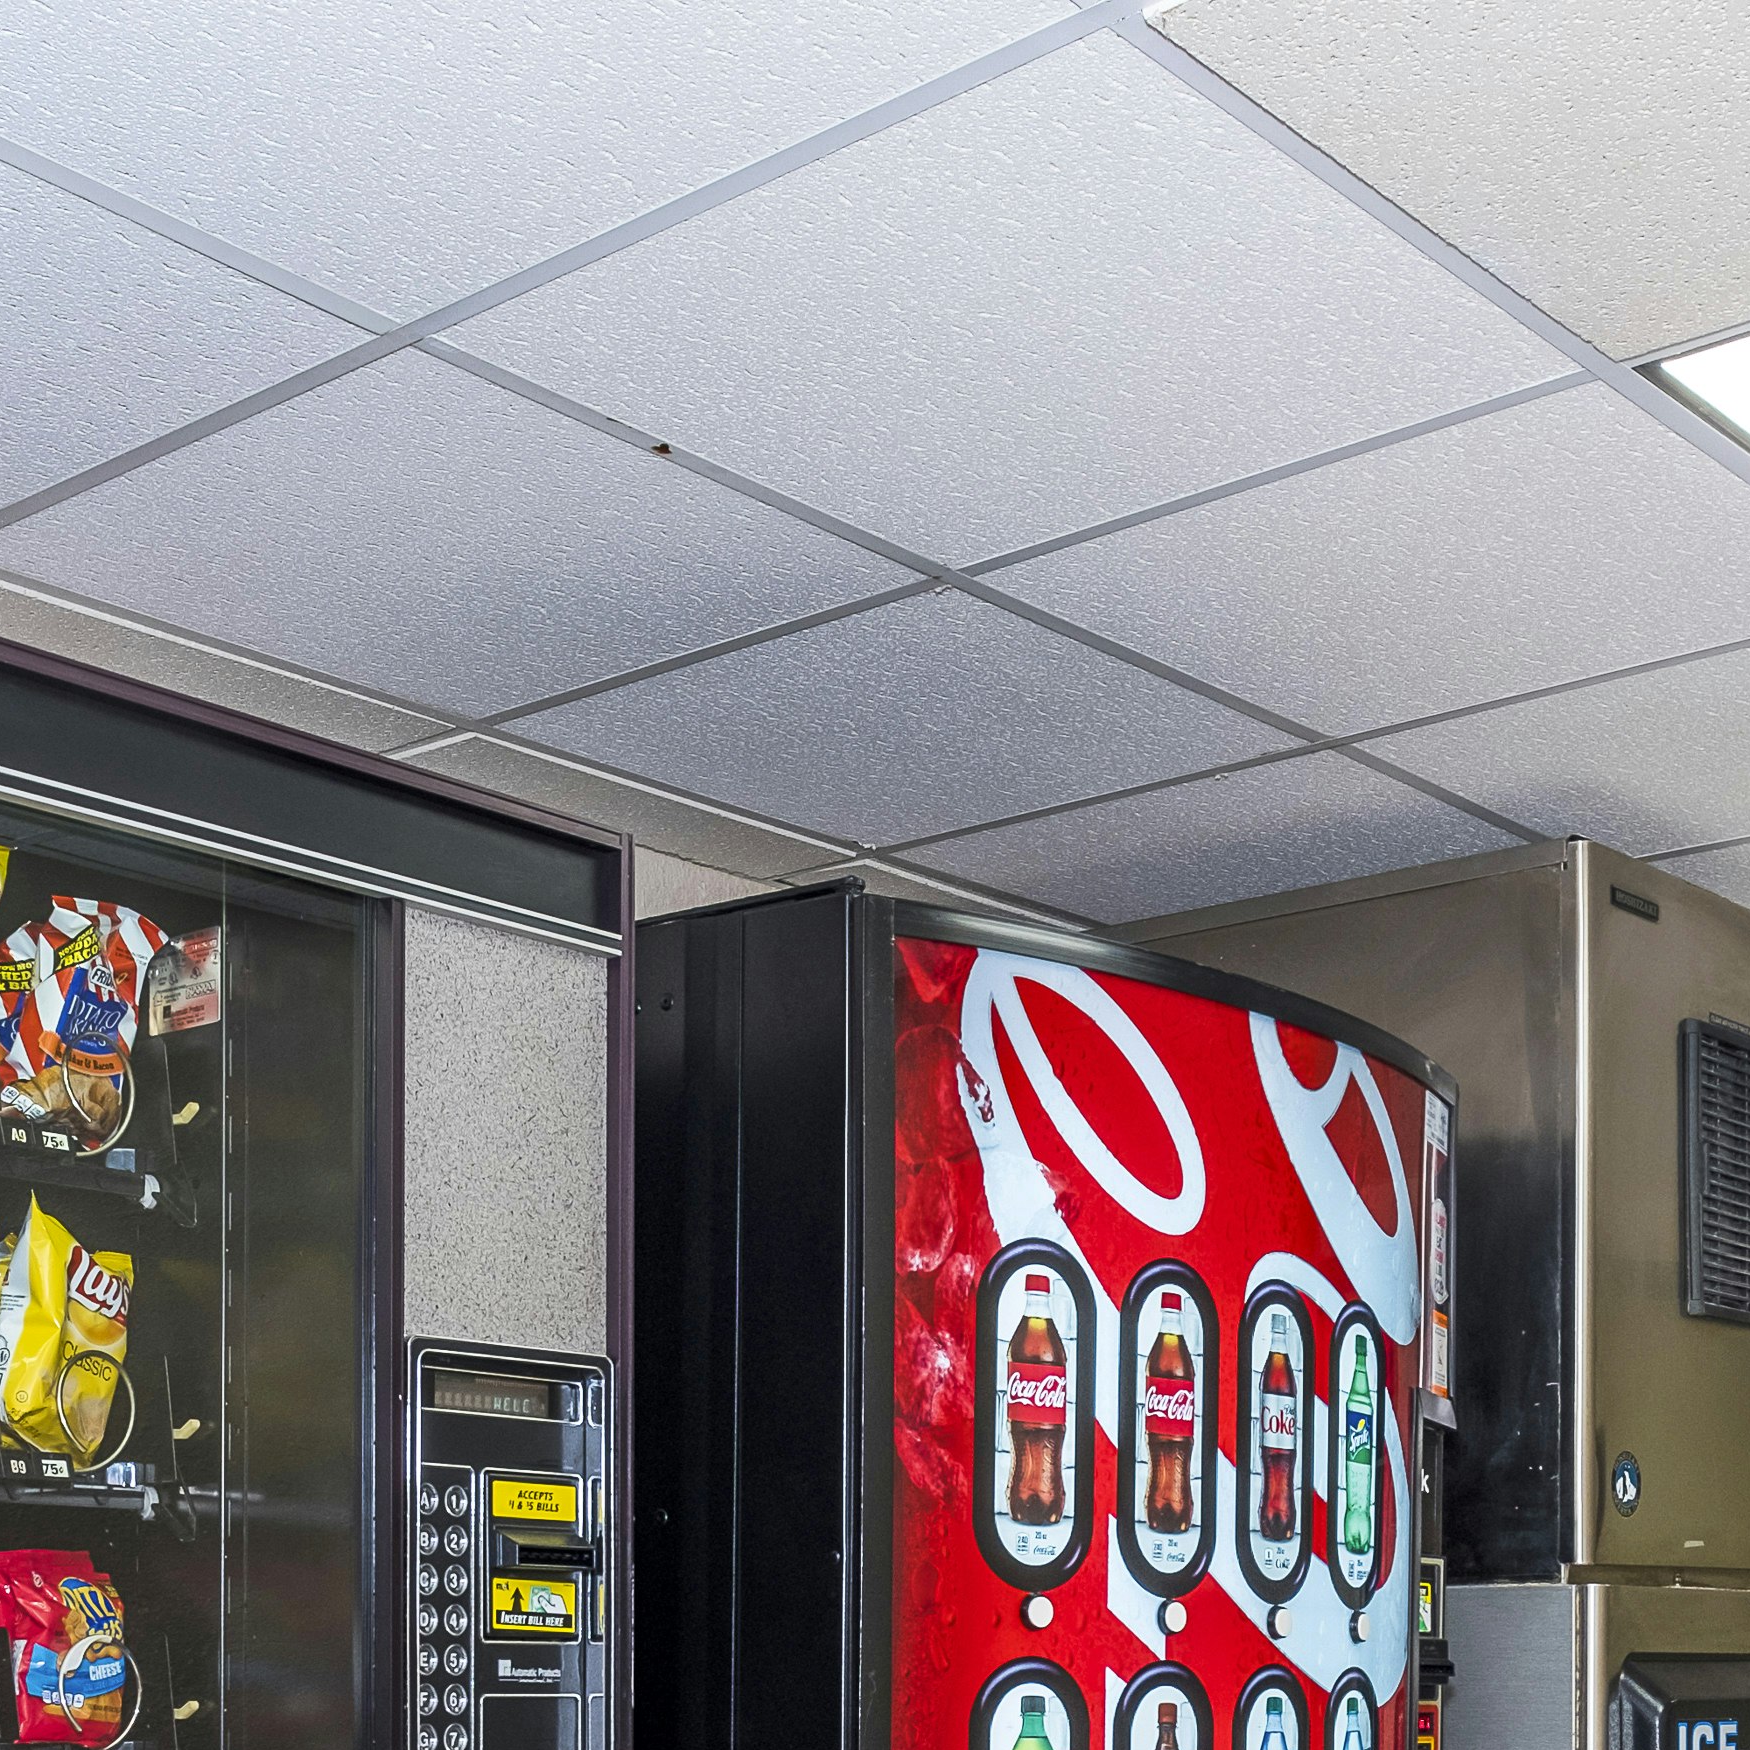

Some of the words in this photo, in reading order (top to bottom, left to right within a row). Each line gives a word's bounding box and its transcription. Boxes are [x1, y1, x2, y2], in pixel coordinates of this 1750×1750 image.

[93, 1059, 115, 1071] Bacon
[11, 1127, 27, 1142] A9
[68, 1245, 131, 1318] Lay's
[62, 1340, 112, 1382] Classic
[1007, 1371, 1066, 1409] Coca-Cola
[1145, 1385, 1194, 1421] Coca-Cola
[1261, 1406, 1295, 1436] Coke
[1349, 1430, 1369, 1452] Sprite
[11, 1459, 26, 1474] B9
[450, 1494, 457, 1508] 1
[517, 1489, 554, 1502] ACCEPTS
[517, 1502, 523, 1511] &
[536, 1502, 560, 1513] BILLS
[449, 1534, 458, 1547] 2
[449, 1573, 458, 1587] 3
[449, 1613, 458, 1626] 4
[500, 1611, 527, 1625] INSERT
[527, 1615, 544, 1626] BILL
[449, 1653, 457, 1668] 5
[89, 1661, 122, 1682] CHEESE
[538, 1667, 561, 1678] Products
[449, 1692, 457, 1707] 6
[449, 1732, 457, 1747] 7
